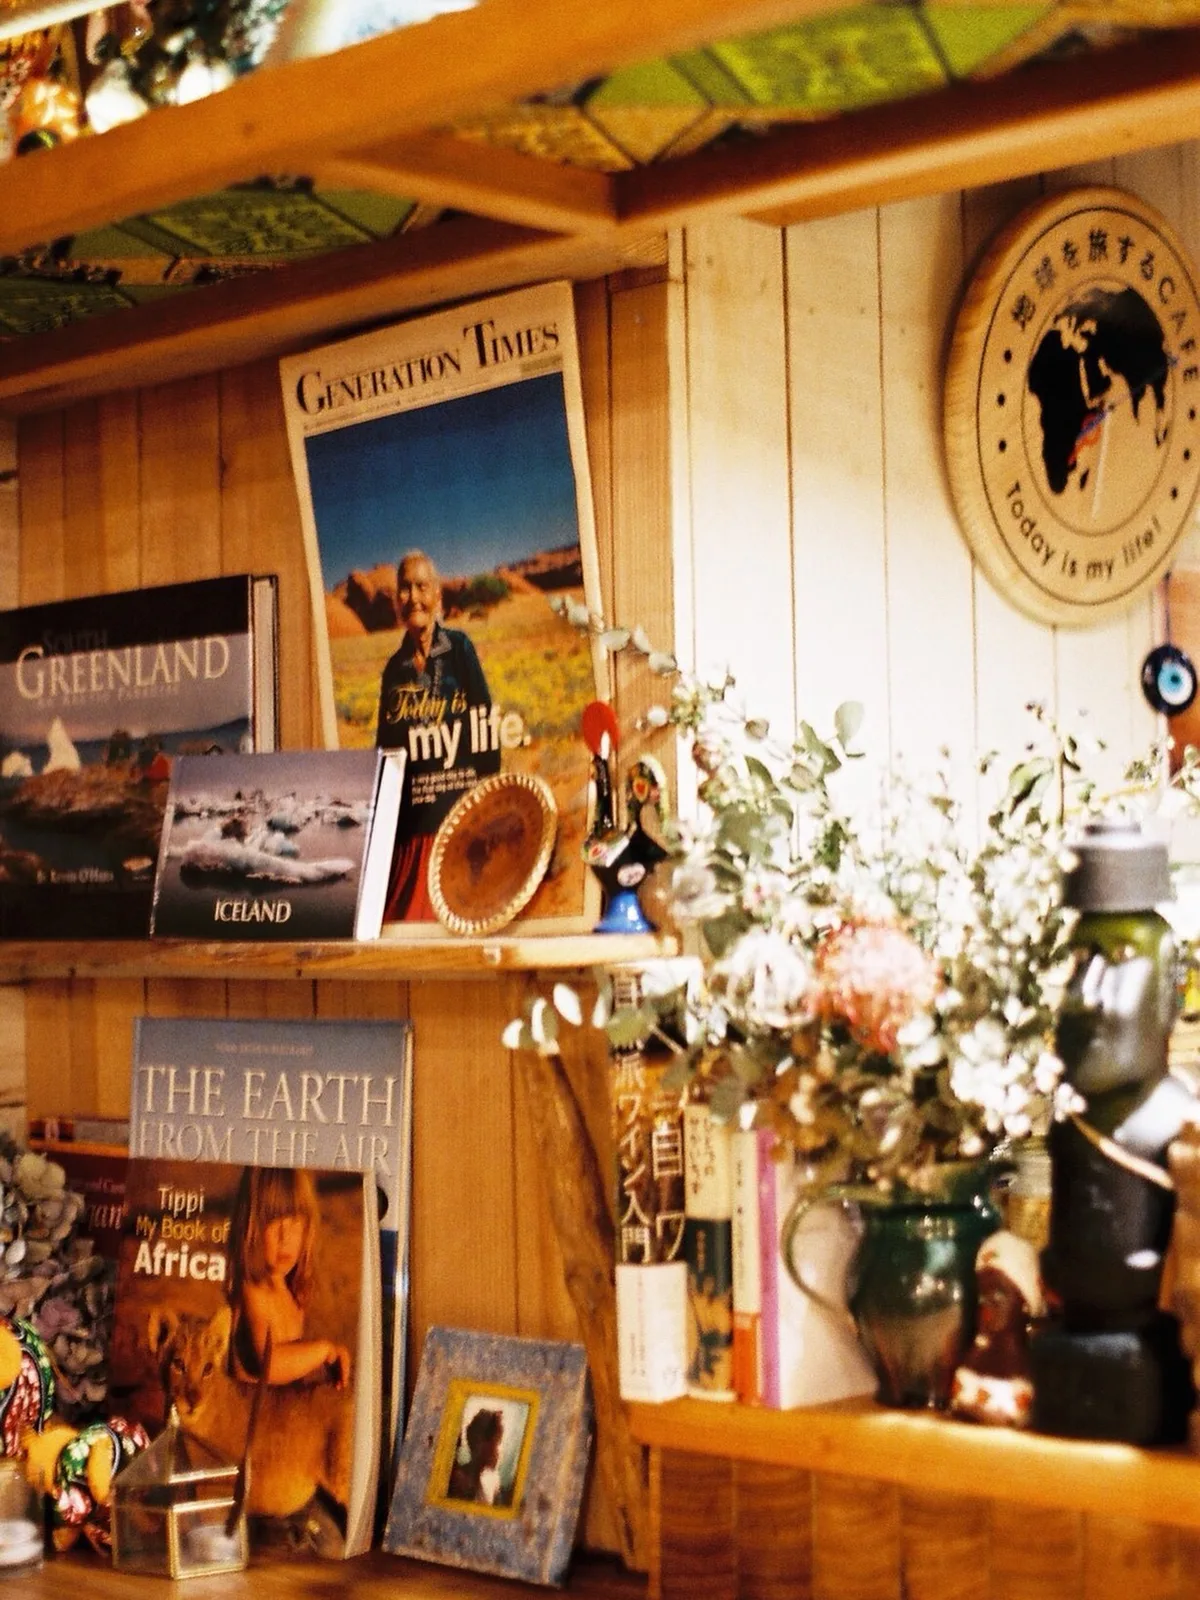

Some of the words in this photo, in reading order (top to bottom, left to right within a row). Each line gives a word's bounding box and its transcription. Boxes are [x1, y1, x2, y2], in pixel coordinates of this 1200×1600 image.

[296, 349, 462, 415] GENERATION
[463, 320, 560, 368] TIMES
[1006, 480, 1055, 567] Today
[1061, 552, 1077, 578] is
[1086, 559, 1114, 580] my
[16, 634, 230, 700] GREENLAND
[386, 683, 448, 726] Today
[451, 689, 468, 714] is
[408, 718, 462, 769] my
[469, 704, 532, 754] life.
[214, 899, 292, 923] ICELAND
[139, 1065, 226, 1117] THE
[243, 1071, 399, 1127] EARTH
[139, 1119, 236, 1163] FROM
[246, 1126, 319, 1167] THE
[333, 1132, 393, 1177] AIR
[136, 1215, 157, 1241] My
[161, 1216, 206, 1241] Book
[212, 1218, 232, 1243] of
[158, 1183, 206, 1218] Tippi
[133, 1239, 227, 1282] Africa
